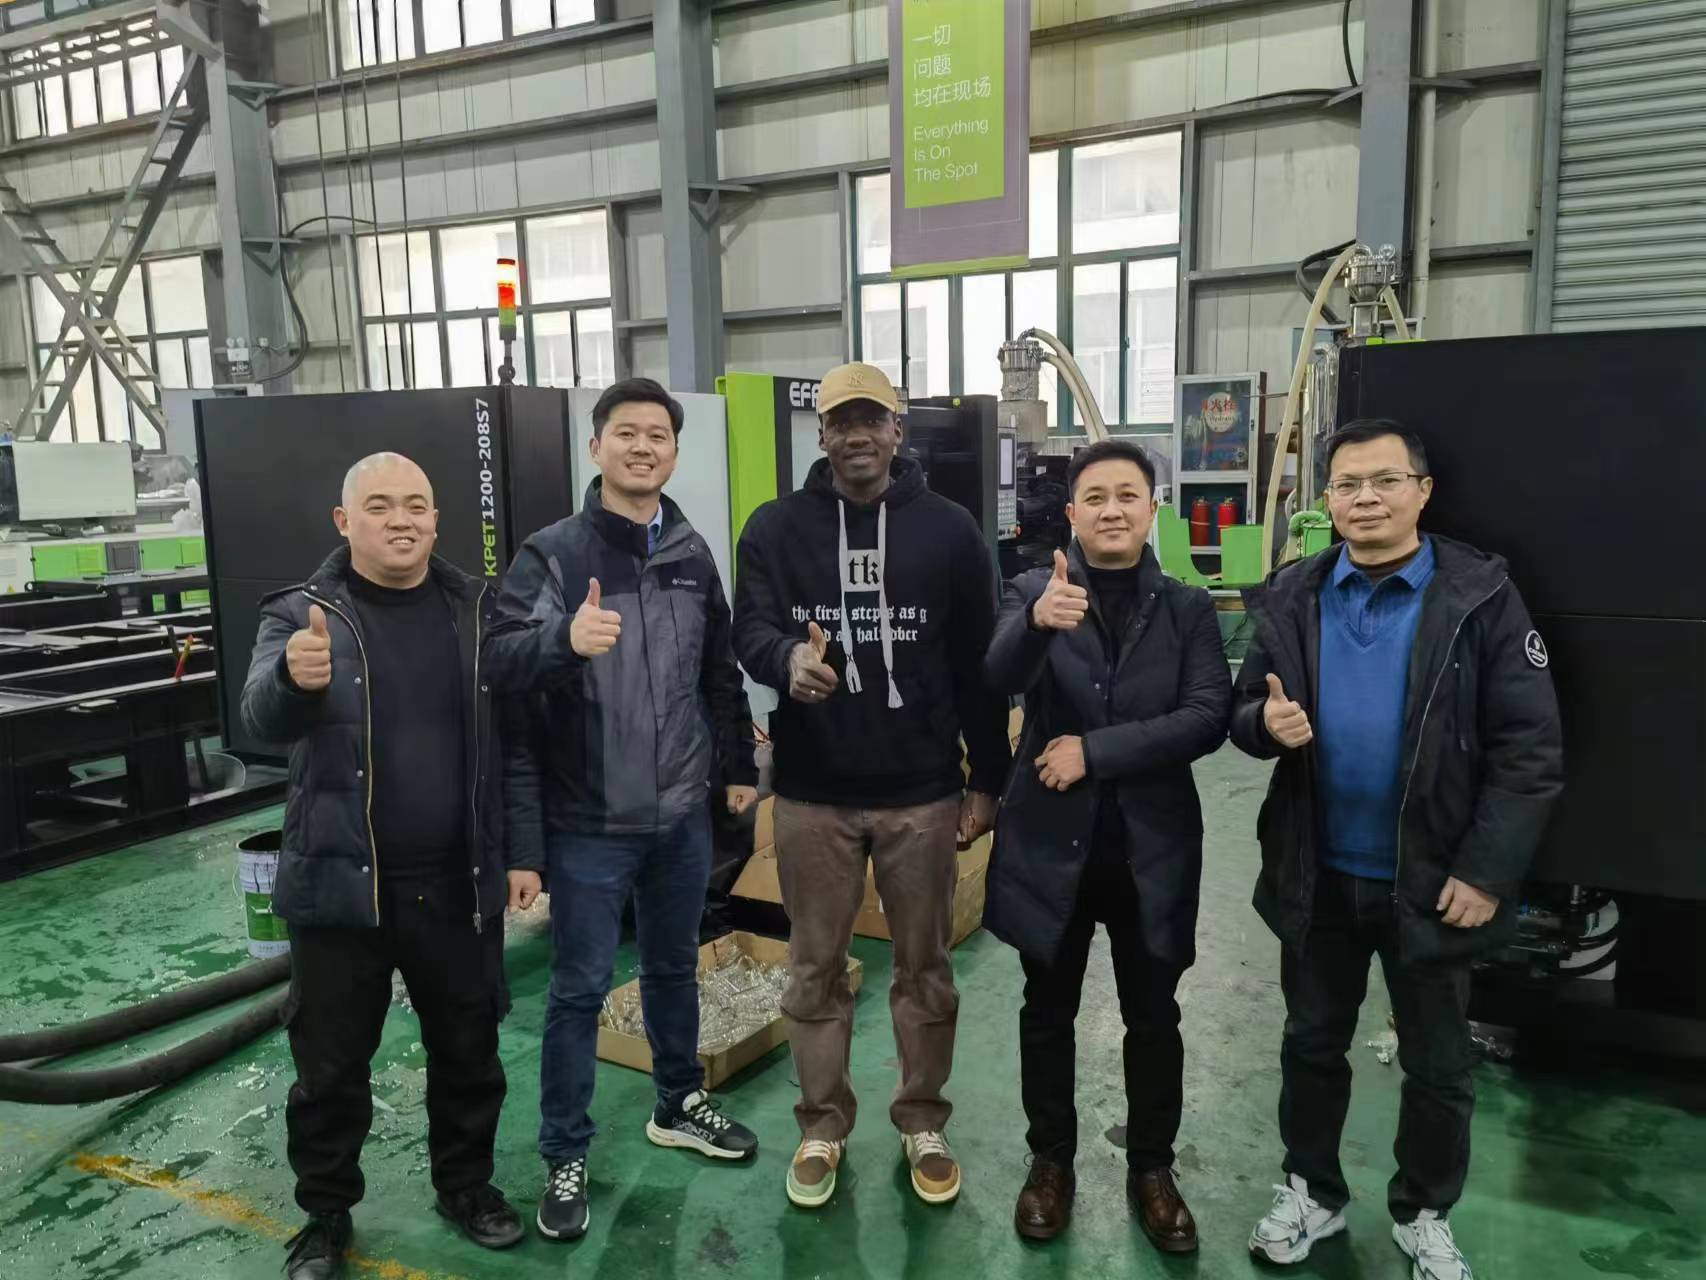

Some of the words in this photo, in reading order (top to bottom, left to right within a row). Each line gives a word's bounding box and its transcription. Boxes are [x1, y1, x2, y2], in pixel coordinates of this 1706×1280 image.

[912, 24, 951, 46] 一切
[913, 54, 951, 80] 问题
[913, 76, 992, 108] 均在现场
[913, 119, 989, 141] Everything
[930, 144, 951, 160] On
[914, 167, 941, 183] The
[944, 161, 977, 181] Spot
[789, 381, 821, 408] EFF
[848, 554, 880, 585] tk
[792, 605, 811, 623] the
[815, 604, 842, 621] firs
[899, 605, 916, 620] as
[856, 626, 881, 644] hal
